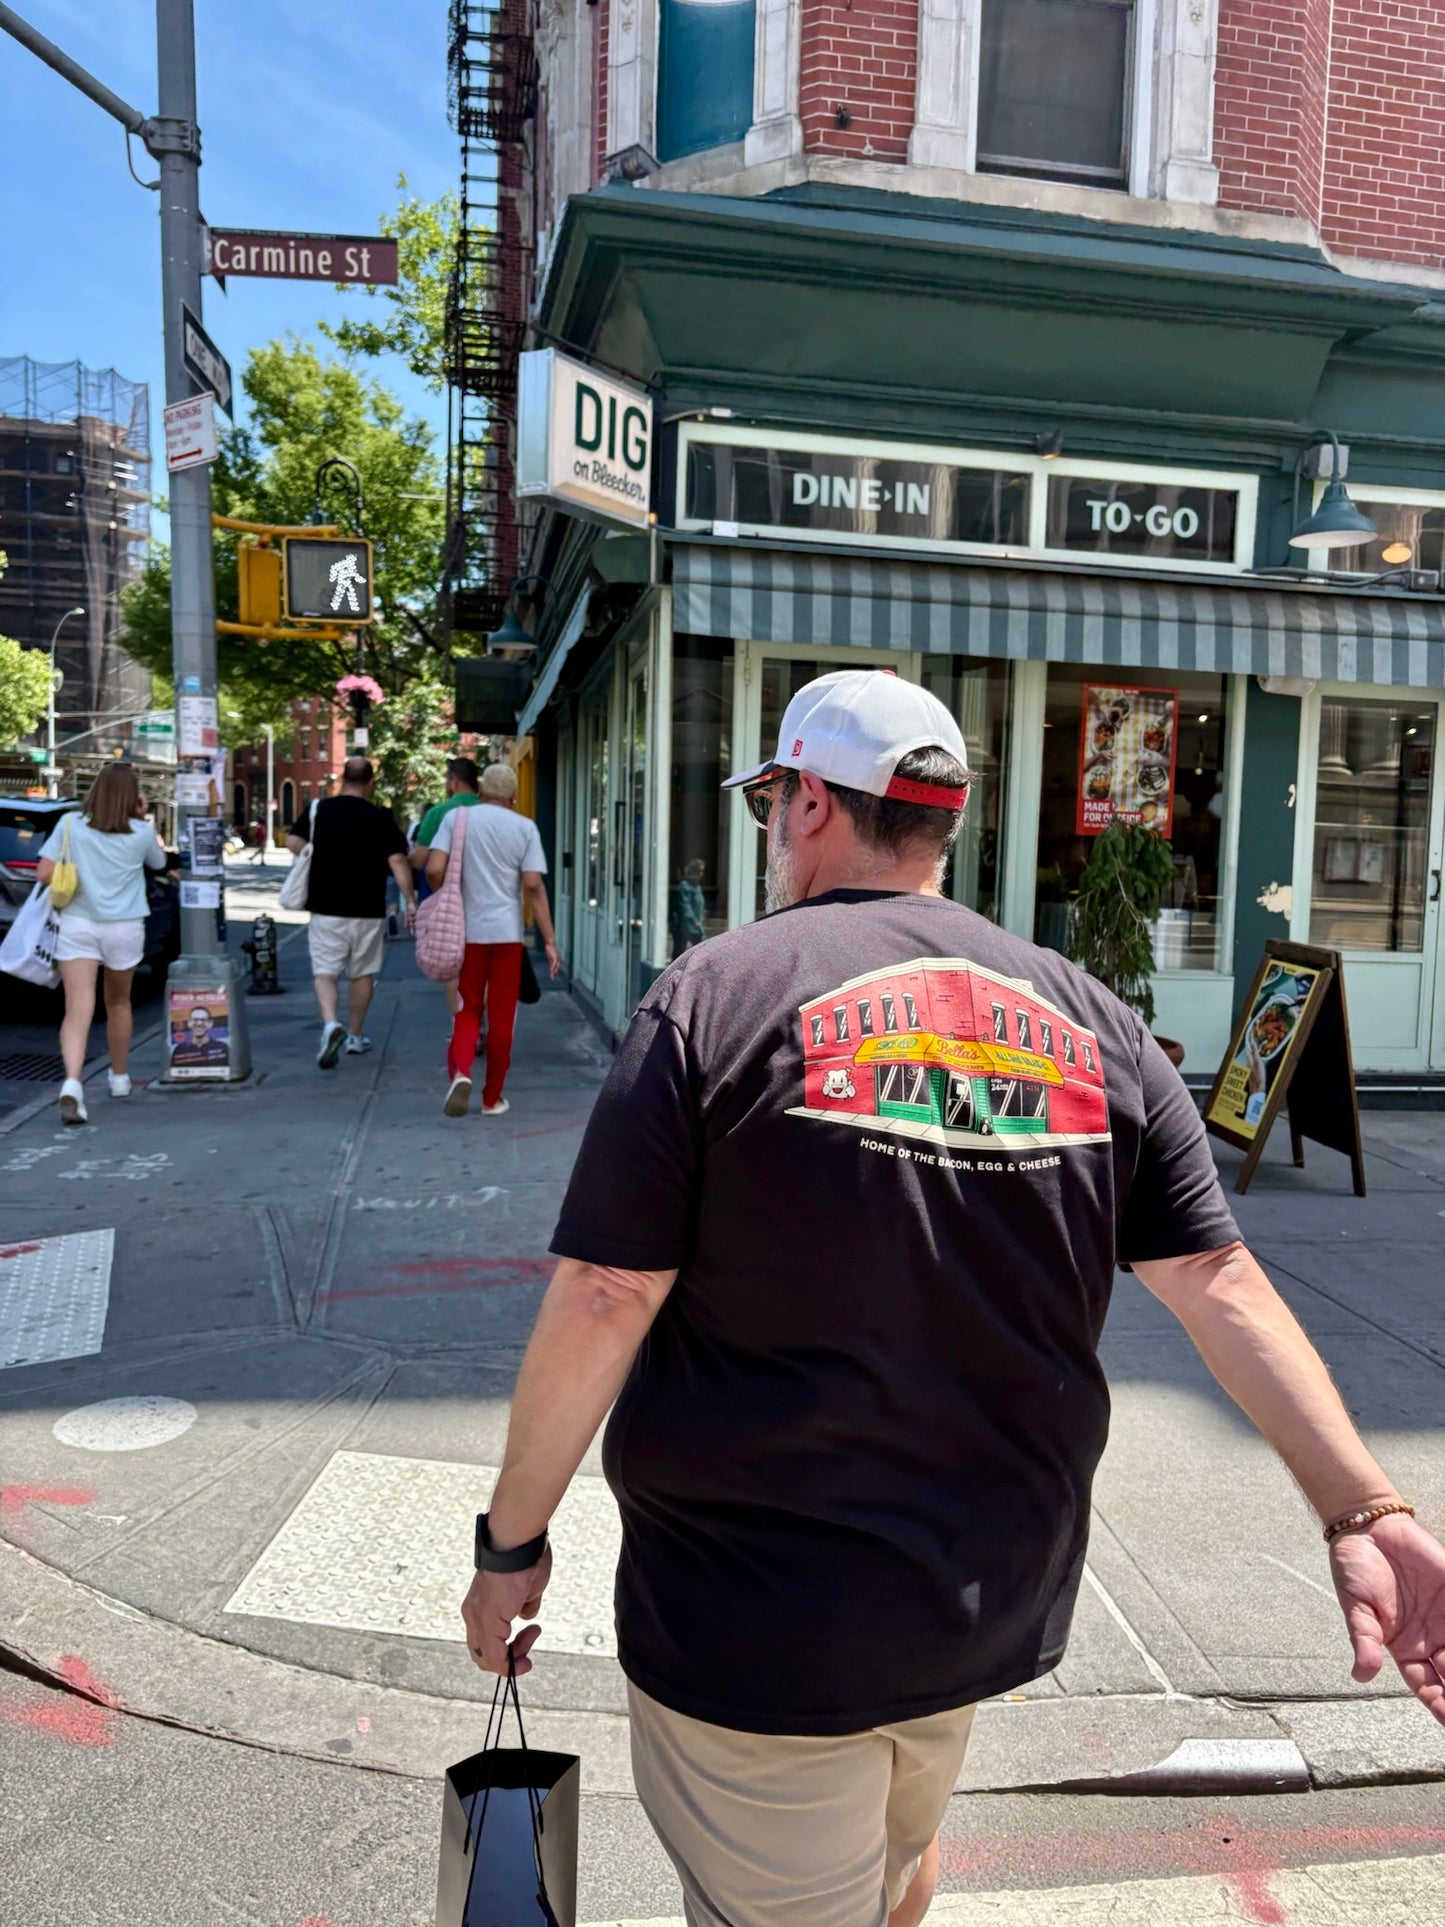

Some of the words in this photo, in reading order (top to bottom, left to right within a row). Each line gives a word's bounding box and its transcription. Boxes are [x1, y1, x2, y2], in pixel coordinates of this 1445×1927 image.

[214, 240, 332, 275] Carmine
[344, 247, 372, 278] St
[575, 380, 648, 471] DIG
[573, 460, 589, 480] on
[1084, 802, 1110, 812] MADE
[1084, 812, 1102, 822] FOR
[936, 1039, 981, 1060] Bella's
[860, 1137, 896, 1156] HOME
[897, 1147, 912, 1160] OF
[913, 1151, 936, 1166] THE
[937, 1157, 974, 1173] BACON,
[977, 1161, 1003, 1172] EGG
[1007, 1162, 1015, 1172] &
[1019, 1155, 1062, 1172] CHEESE
